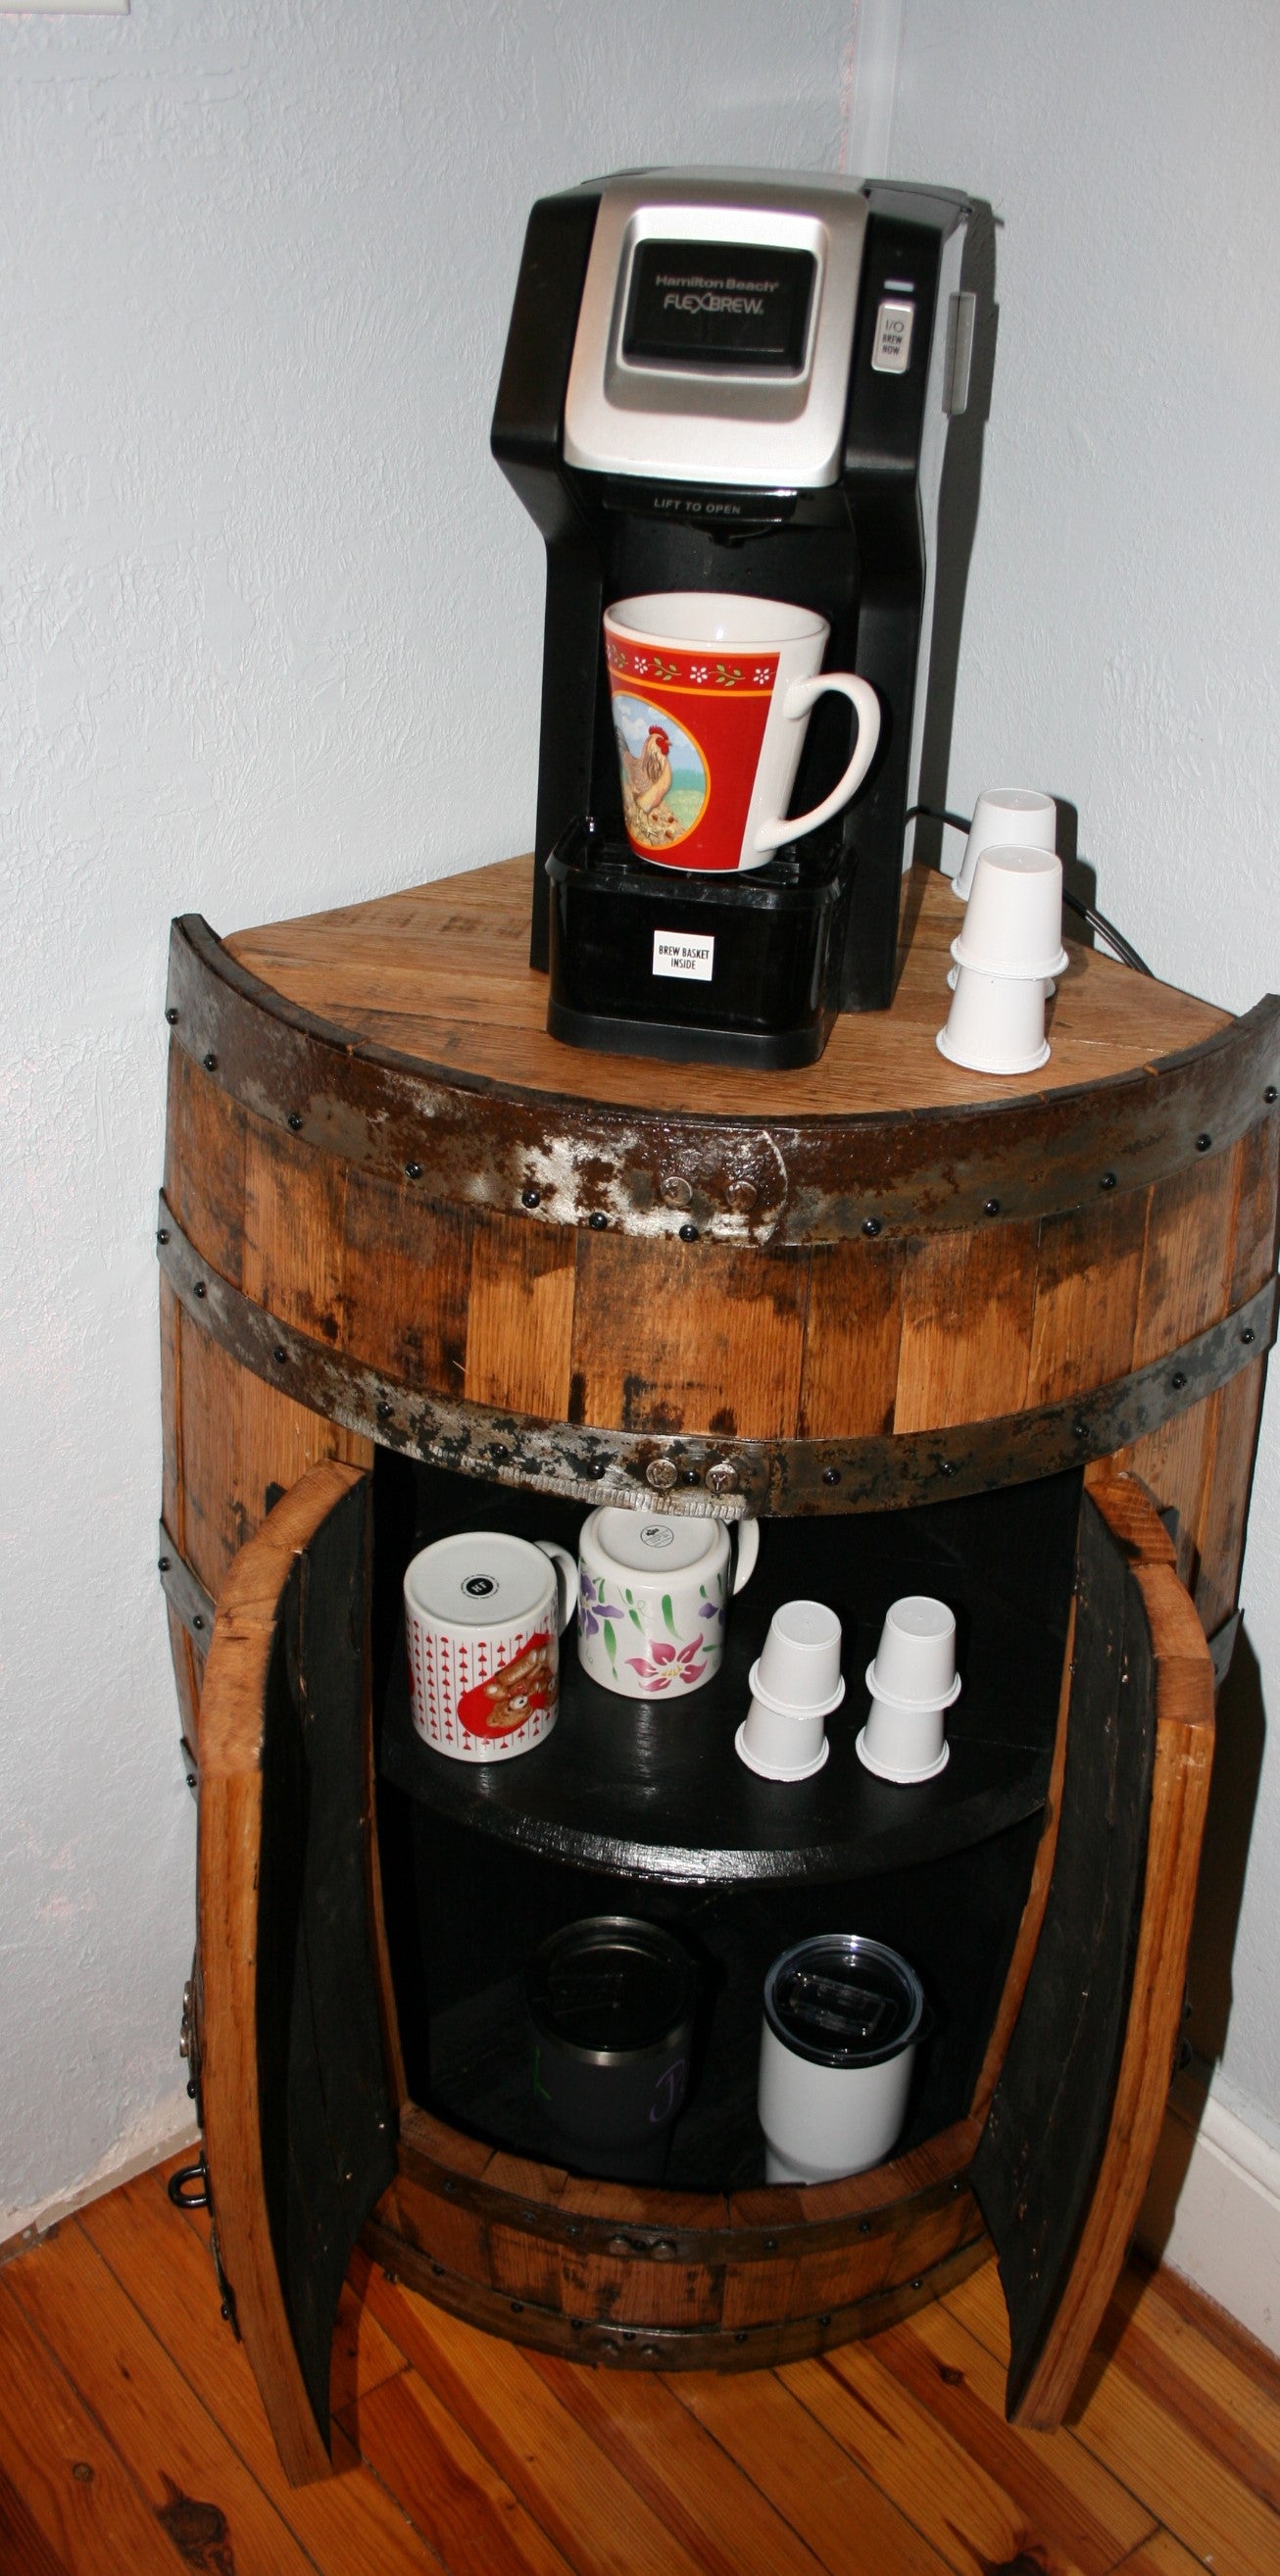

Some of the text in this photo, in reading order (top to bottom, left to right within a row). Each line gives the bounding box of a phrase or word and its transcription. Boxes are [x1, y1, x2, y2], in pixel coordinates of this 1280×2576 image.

[656, 274, 724, 289] Hamilton
[882, 334, 903, 344] BREW
[882, 345, 901, 355] NOW
[654, 498, 741, 515] LIFT TO OPEN
[659, 945, 710, 960] BREW BASKET
[670, 958, 696, 969] INSIDE
